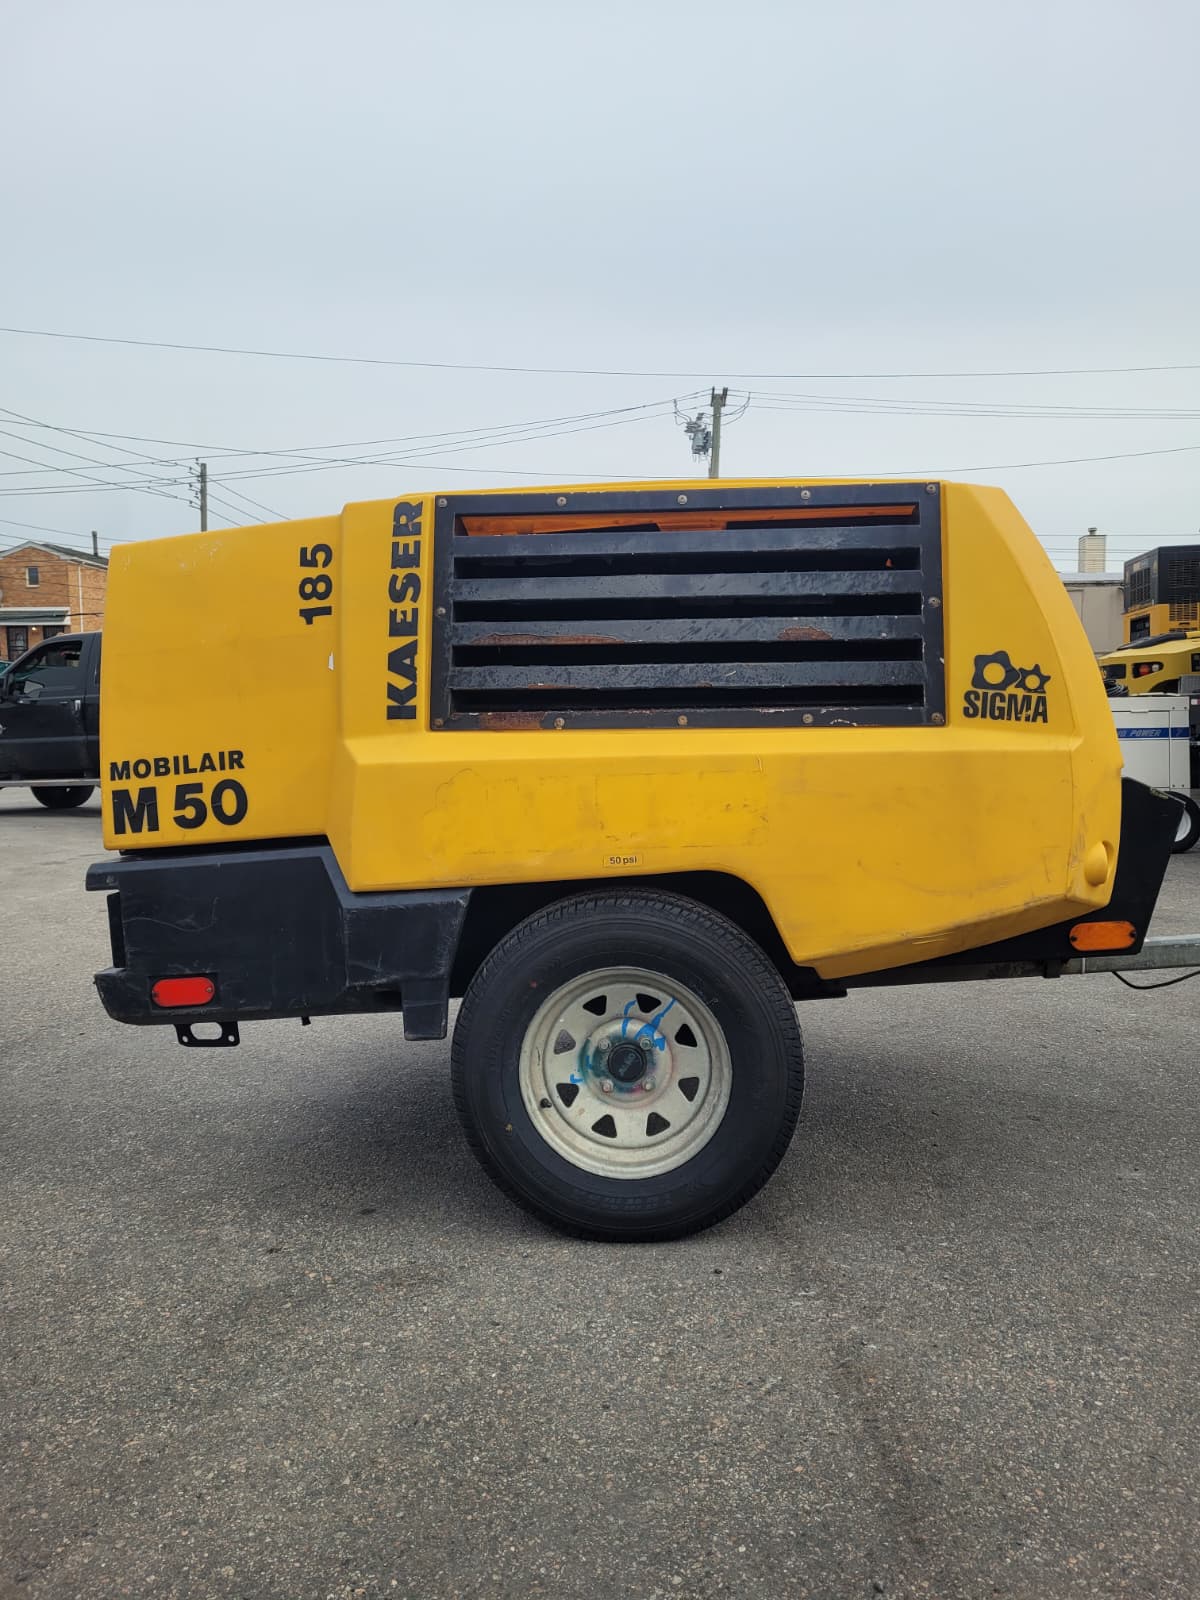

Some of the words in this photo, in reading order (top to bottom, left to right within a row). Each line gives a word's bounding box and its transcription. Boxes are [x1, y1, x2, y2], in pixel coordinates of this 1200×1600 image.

[298, 543, 333, 625] 185
[386, 500, 424, 720] KAESER
[962, 690, 1048, 723] SIGMA
[110, 750, 245, 781] MOBILAIR
[112, 786, 160, 835] M
[173, 778, 248, 829] 50
[609, 856, 622, 865] 50
[622, 856, 638, 865] psi
